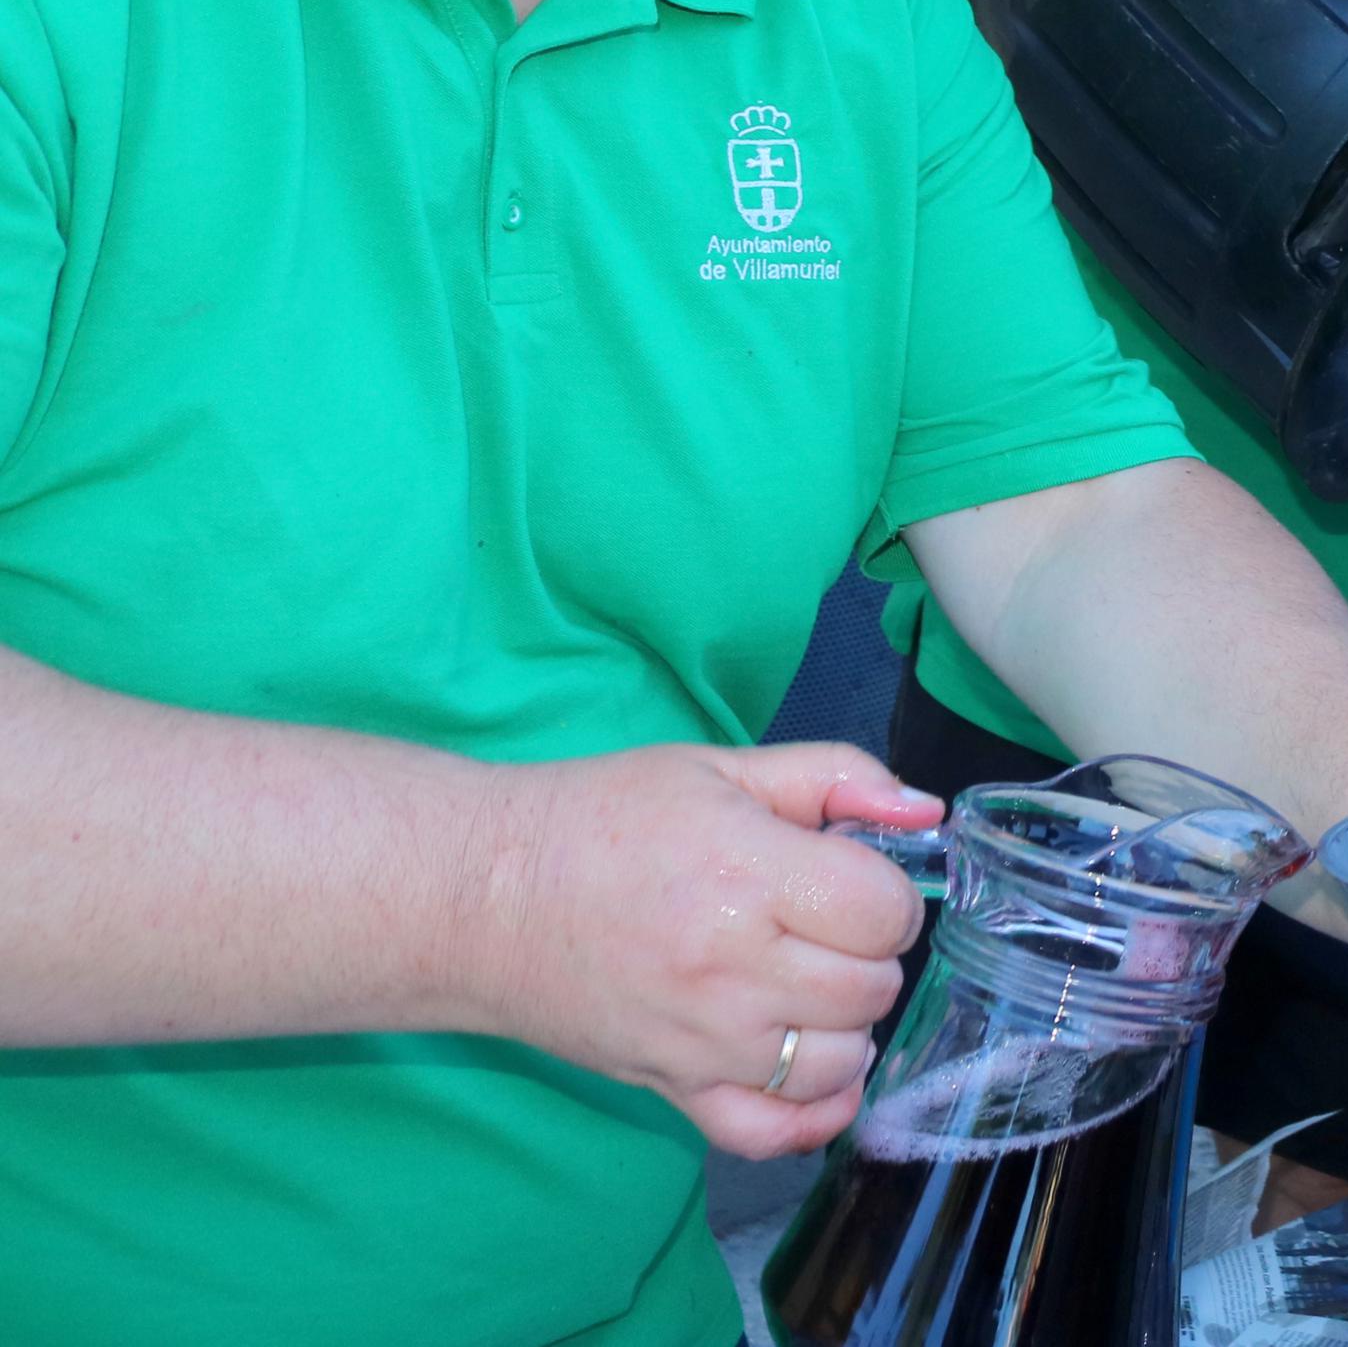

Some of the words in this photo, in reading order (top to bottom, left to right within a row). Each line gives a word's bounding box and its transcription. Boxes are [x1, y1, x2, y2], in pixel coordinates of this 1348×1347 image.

[706, 235, 832, 257] Ayuntamiento
[699, 259, 727, 281] de
[732, 258, 842, 281] Villamuriel
